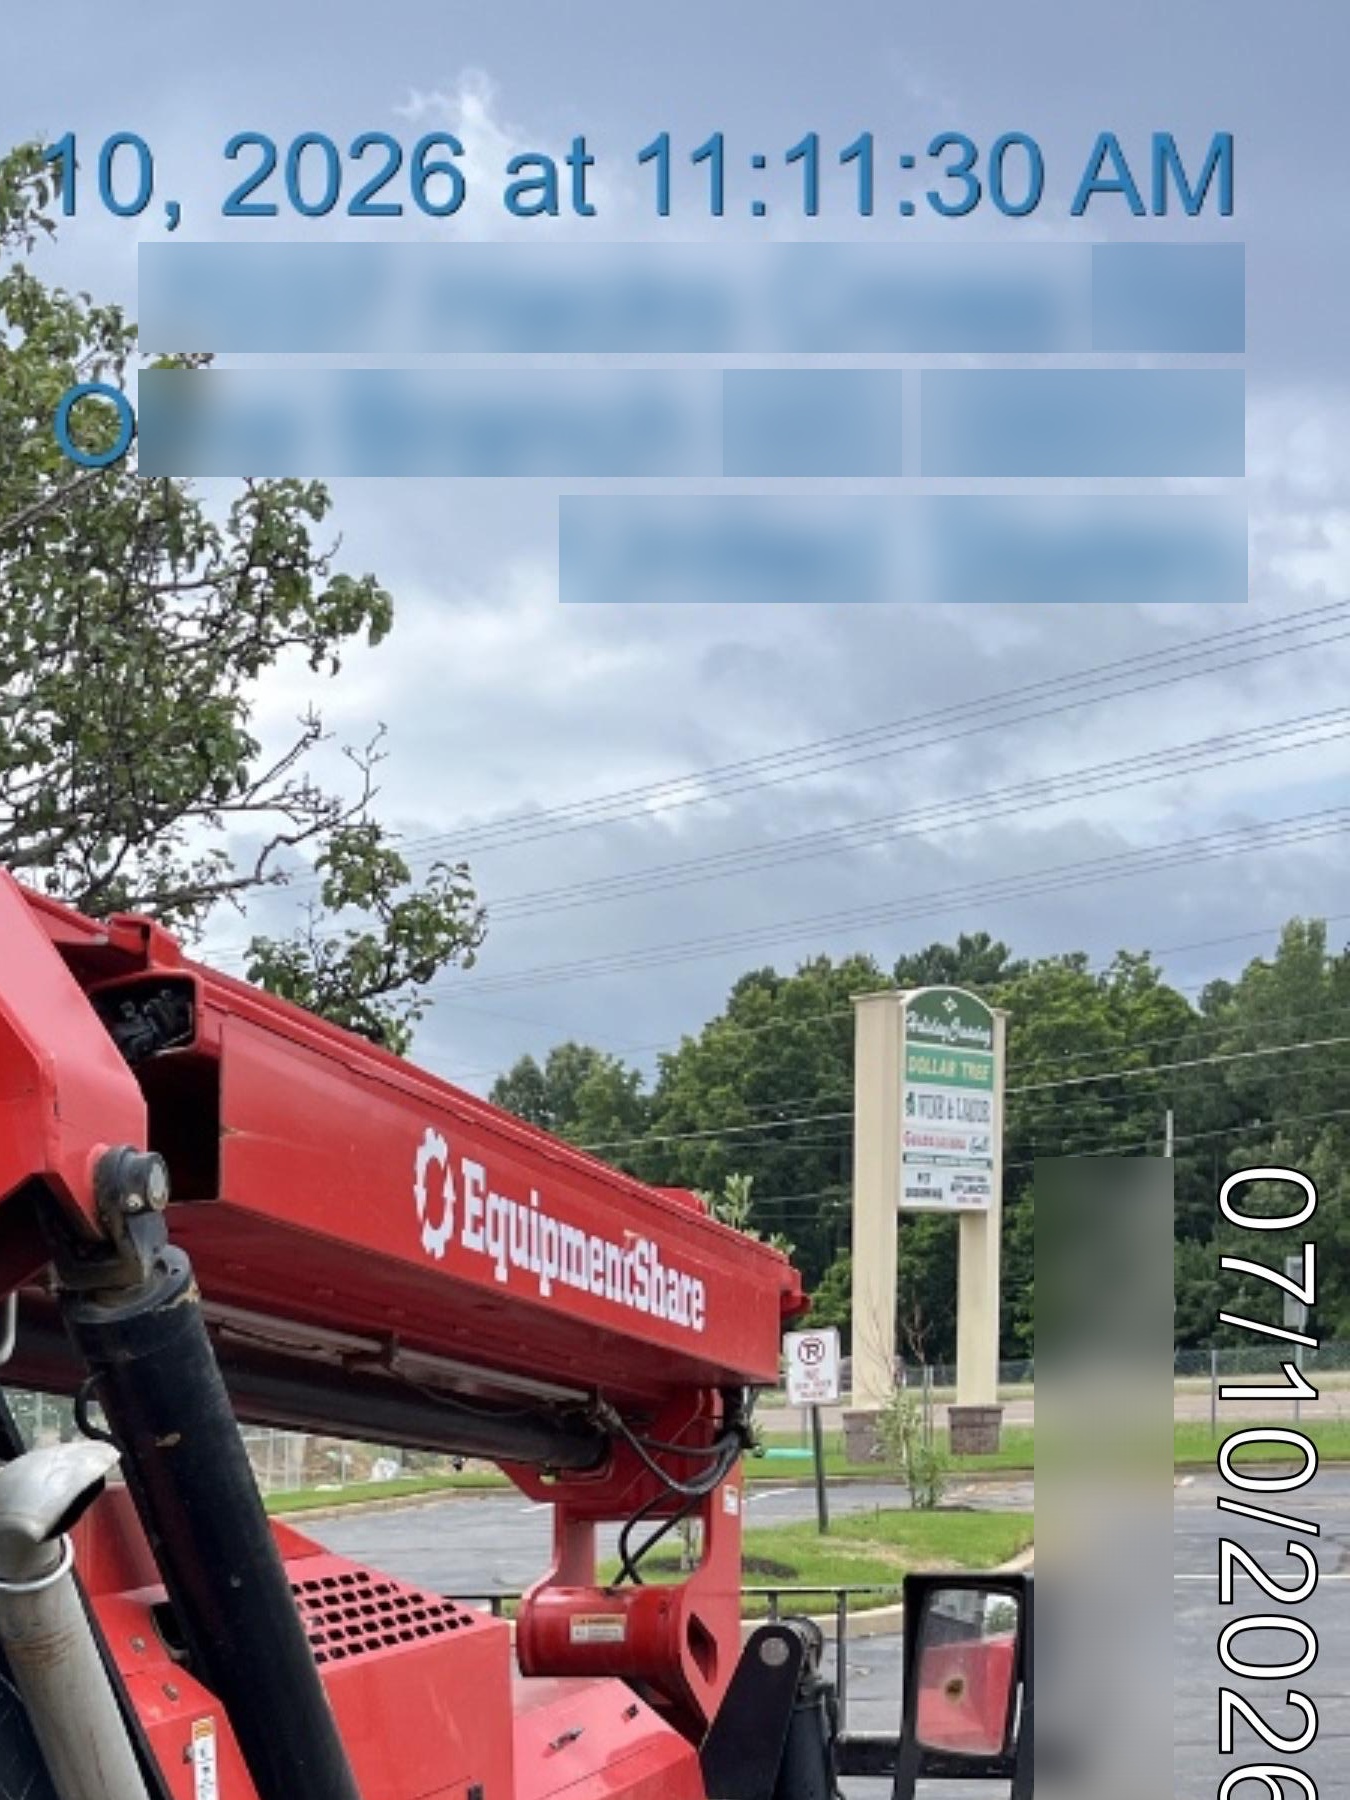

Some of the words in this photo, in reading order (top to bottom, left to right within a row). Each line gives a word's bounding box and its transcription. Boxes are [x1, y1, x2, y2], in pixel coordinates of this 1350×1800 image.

[908, 1055, 956, 1078] DOLLAR
[962, 1061, 991, 1081] TREE
[461, 1157, 707, 1333] EquipmentShare
